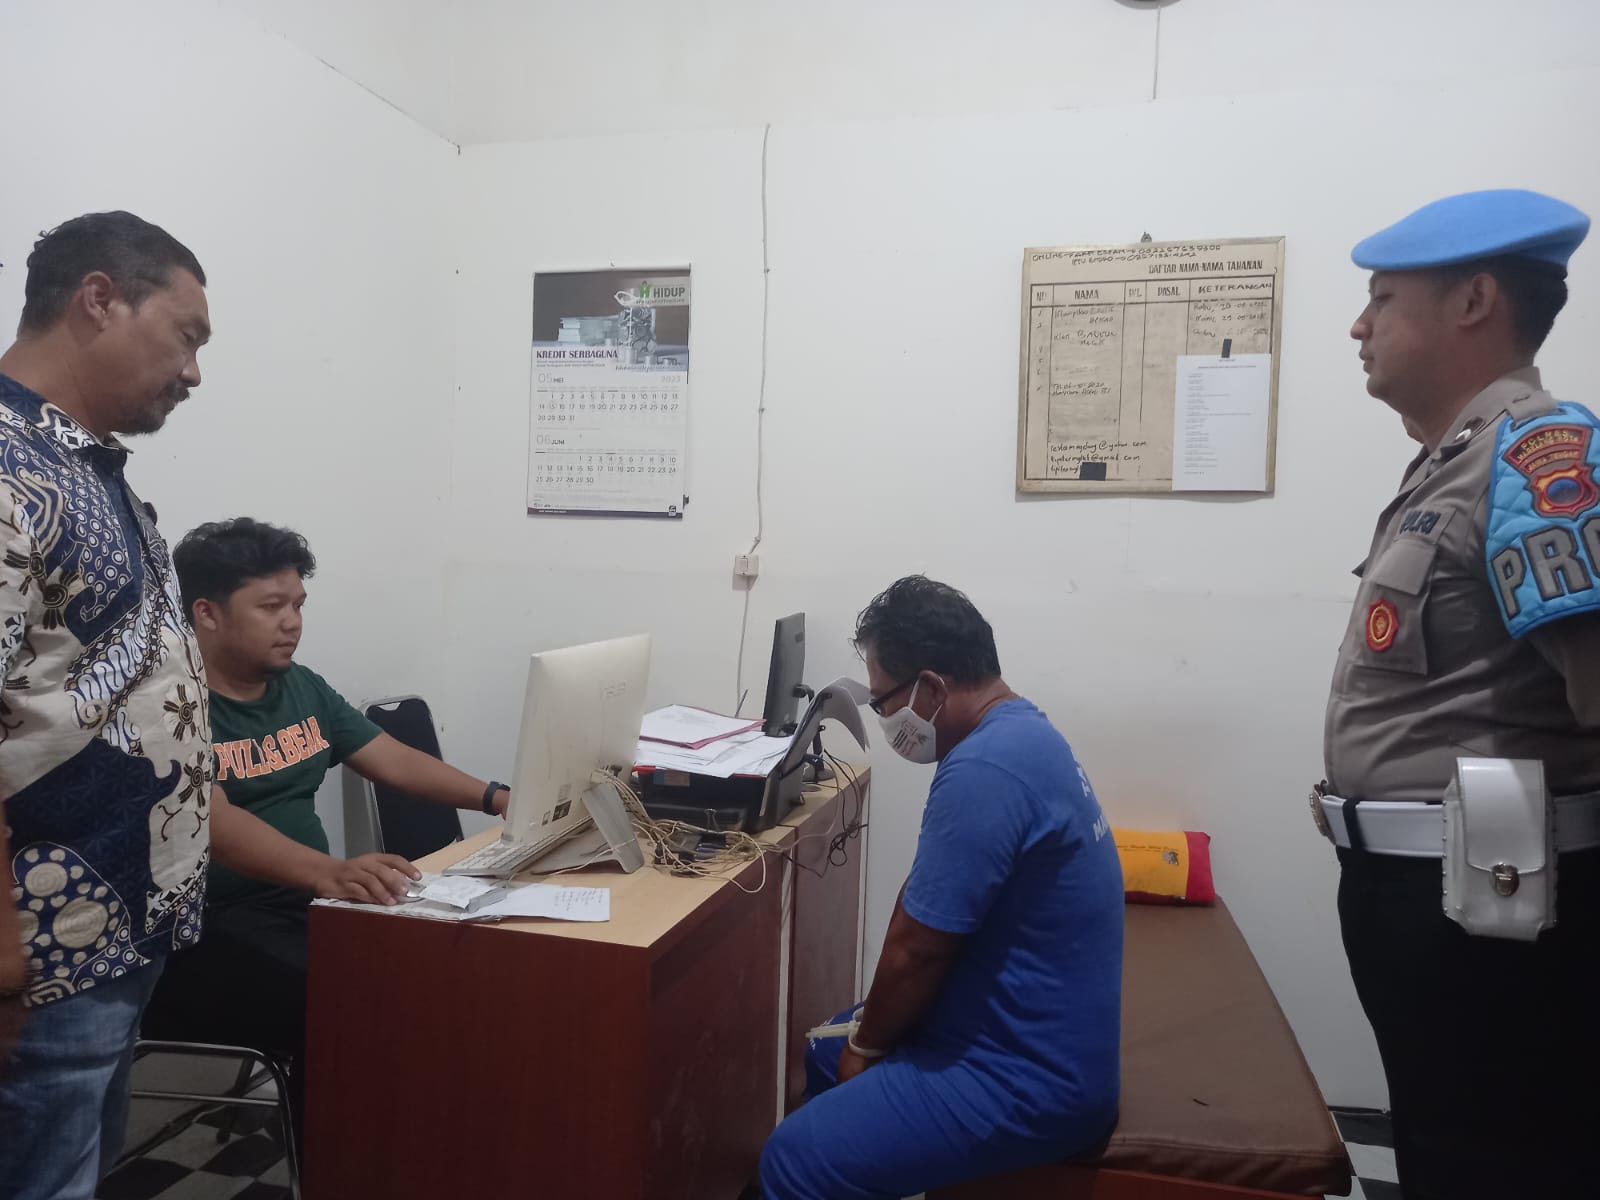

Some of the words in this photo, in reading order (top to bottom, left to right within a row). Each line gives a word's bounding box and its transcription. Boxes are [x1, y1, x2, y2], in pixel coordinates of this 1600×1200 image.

[1148, 264, 1177, 274] DAFTAR
[1178, 262, 1224, 273] NAMA-NAMA
[1226, 260, 1263, 271] TAHANAN
[653, 287, 686, 298] HIDUP
[1157, 286, 1181, 297] PASAL
[1198, 282, 1272, 294] KETERANGAN
[1074, 289, 1100, 300] NAMA
[536, 350, 566, 358] KREDIT
[569, 350, 618, 358] SERBAGUNA
[536, 434, 551, 445] 06
